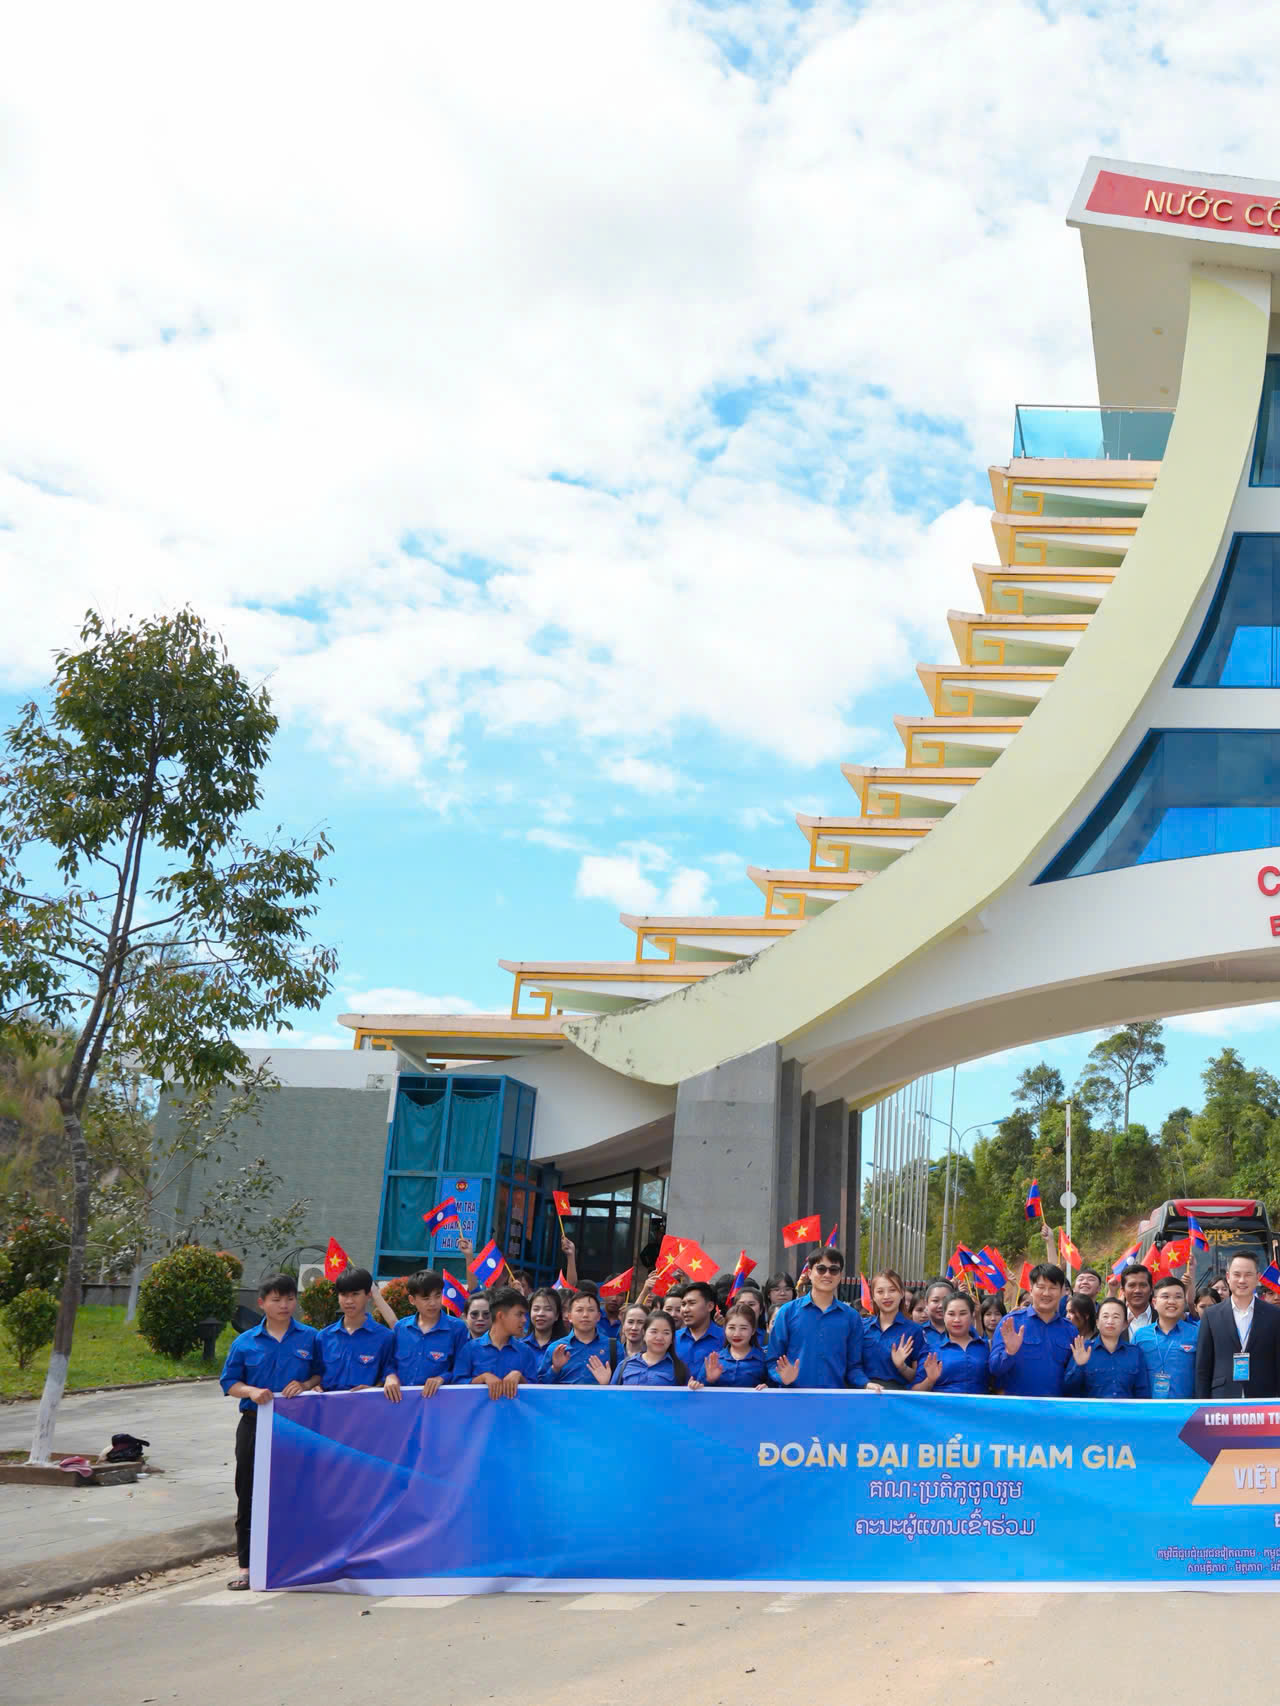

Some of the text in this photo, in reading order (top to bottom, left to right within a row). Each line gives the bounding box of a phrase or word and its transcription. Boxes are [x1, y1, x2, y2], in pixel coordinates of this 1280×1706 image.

[1143, 188, 1233, 224] NƯỚC
[464, 1202, 476, 1213] TRA
[1204, 1412, 1229, 1426] LIÊN
[1233, 1413, 1264, 1425] HOAN
[758, 1434, 1136, 1475] ĐOÀN ĐẠI BIỂU THAM GIA
[1234, 1465, 1279, 1494] VIỆT
